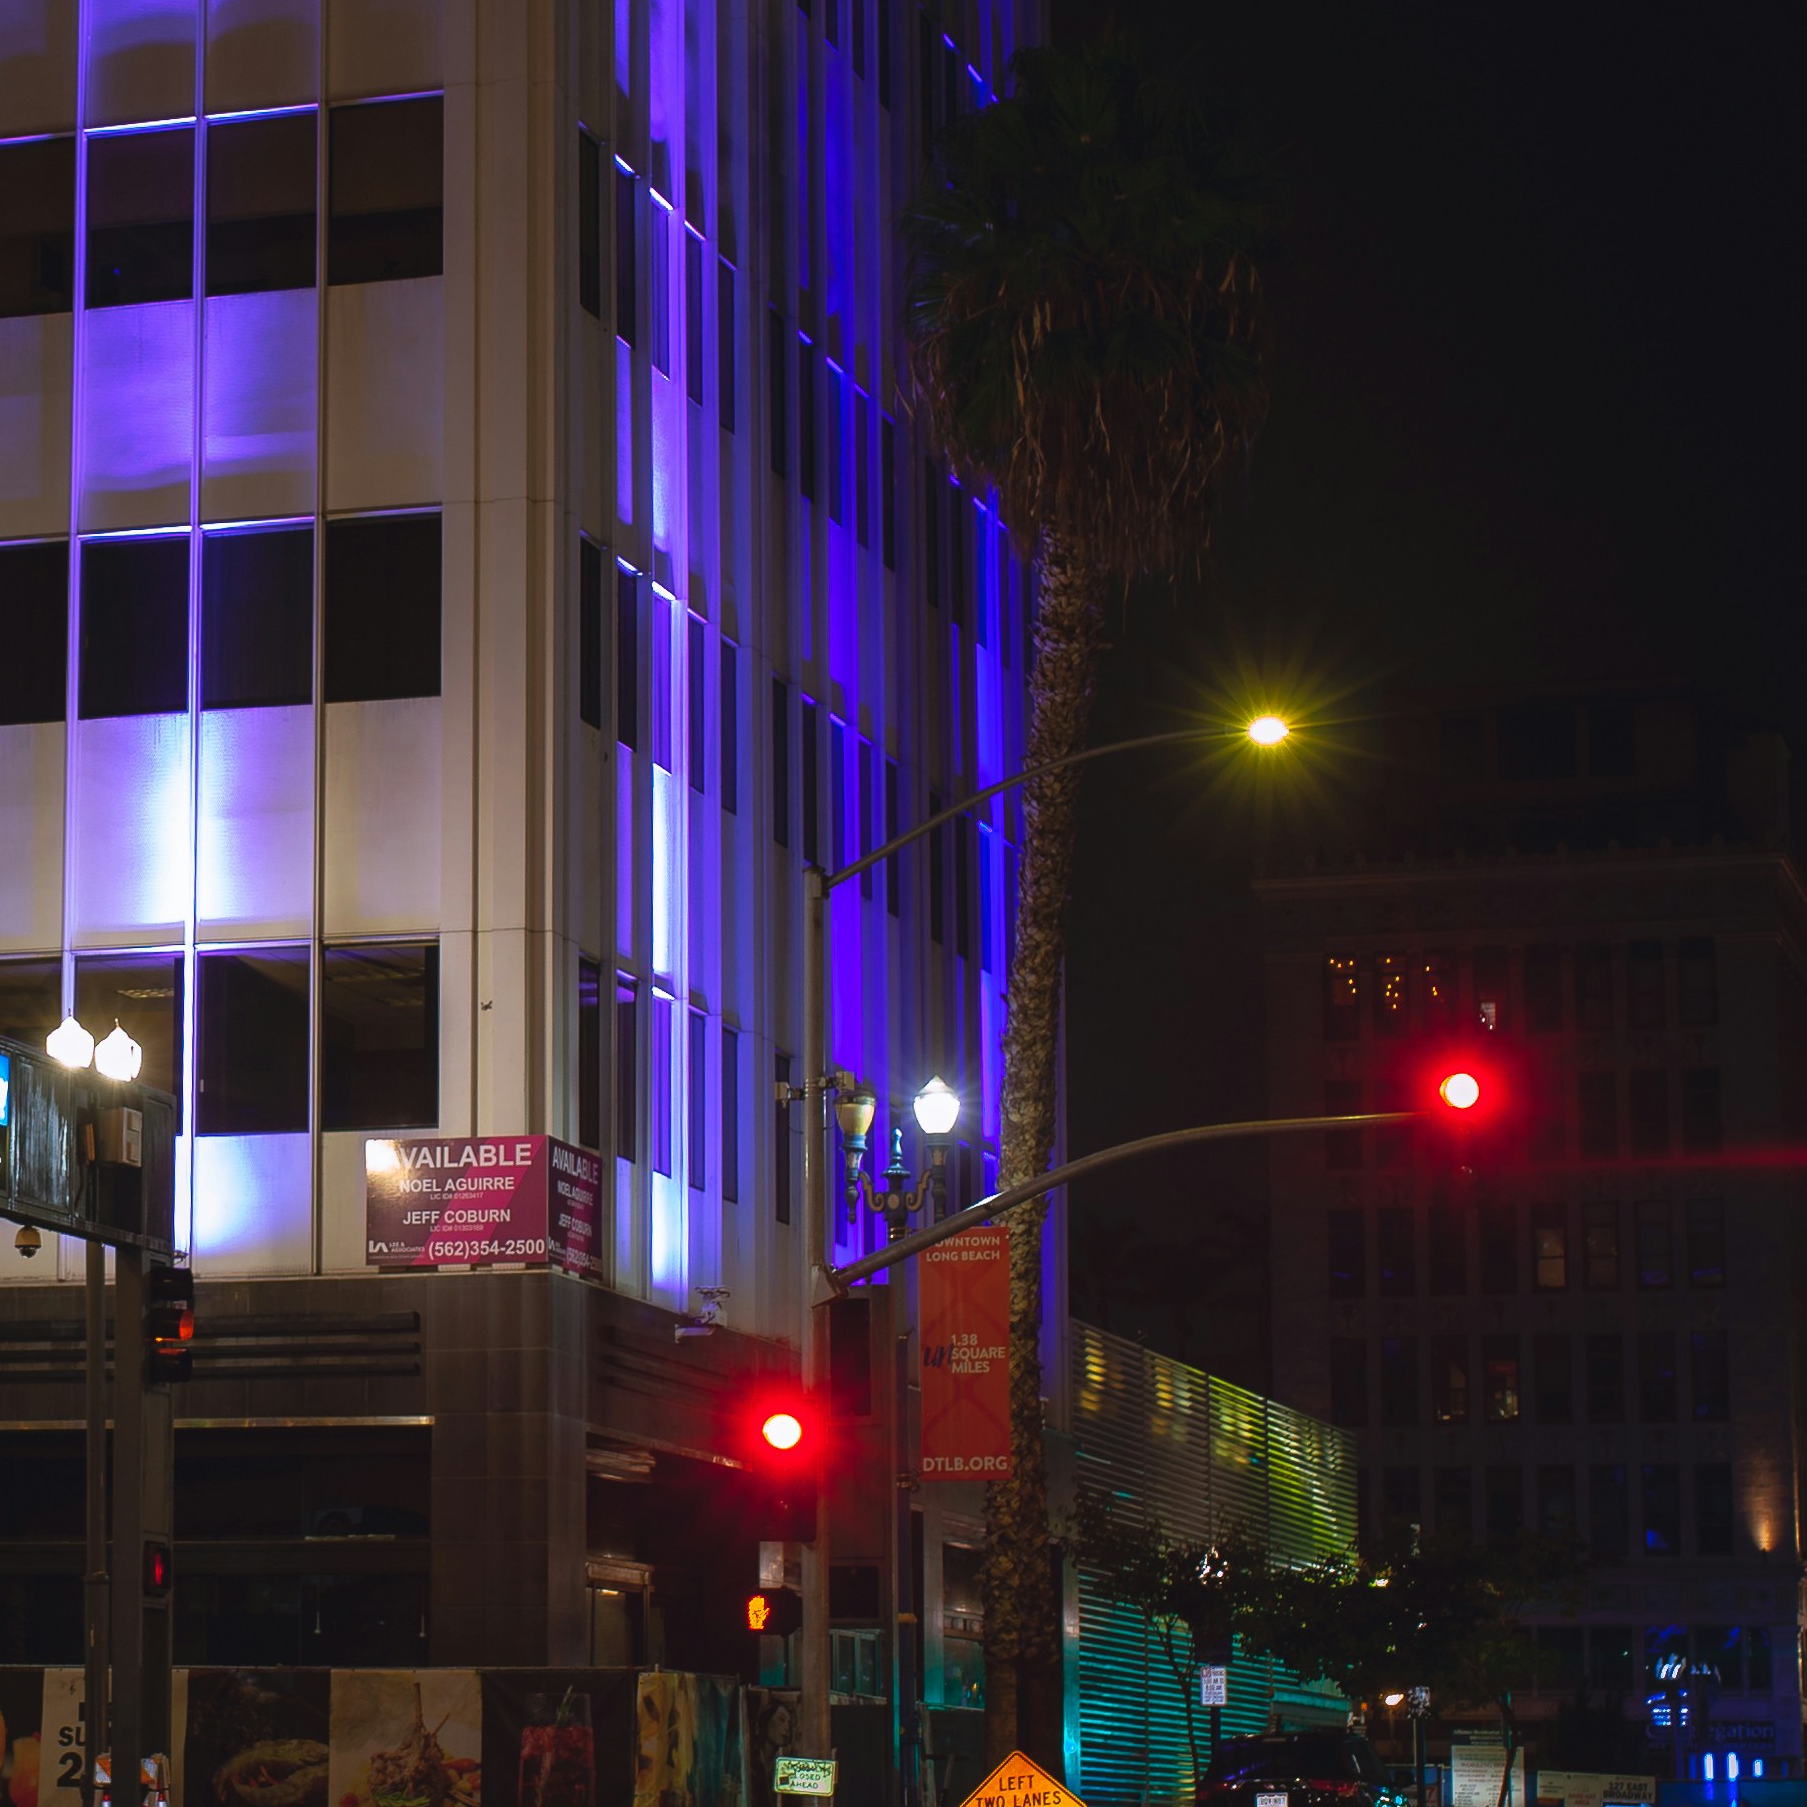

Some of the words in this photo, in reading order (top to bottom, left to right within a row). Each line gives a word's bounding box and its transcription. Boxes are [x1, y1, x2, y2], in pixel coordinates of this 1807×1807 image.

[398, 1143, 532, 1169] VAILABLE
[552, 1145, 598, 1185] AVAILABLE
[399, 1179, 442, 1193] NOEL
[444, 1177, 515, 1192] AGUIRRE
[402, 1211, 440, 1224] JEFF
[444, 1209, 511, 1223] COBURN
[428, 1239, 545, 1261] (562)354-2500
[926, 1251, 958, 1262] LONG
[961, 1250, 1000, 1261] BEACH
[951, 1334, 978, 1346] 1.38
[951, 1346, 1006, 1363] SQUARE
[951, 1361, 990, 1374] MILES
[922, 1456, 1008, 1472] DTLB.ORG
[999, 1774, 1035, 1792] LEFT
[1627, 1782, 1648, 1792] EAST
[1602, 1790, 1653, 1800] BROADWAY
